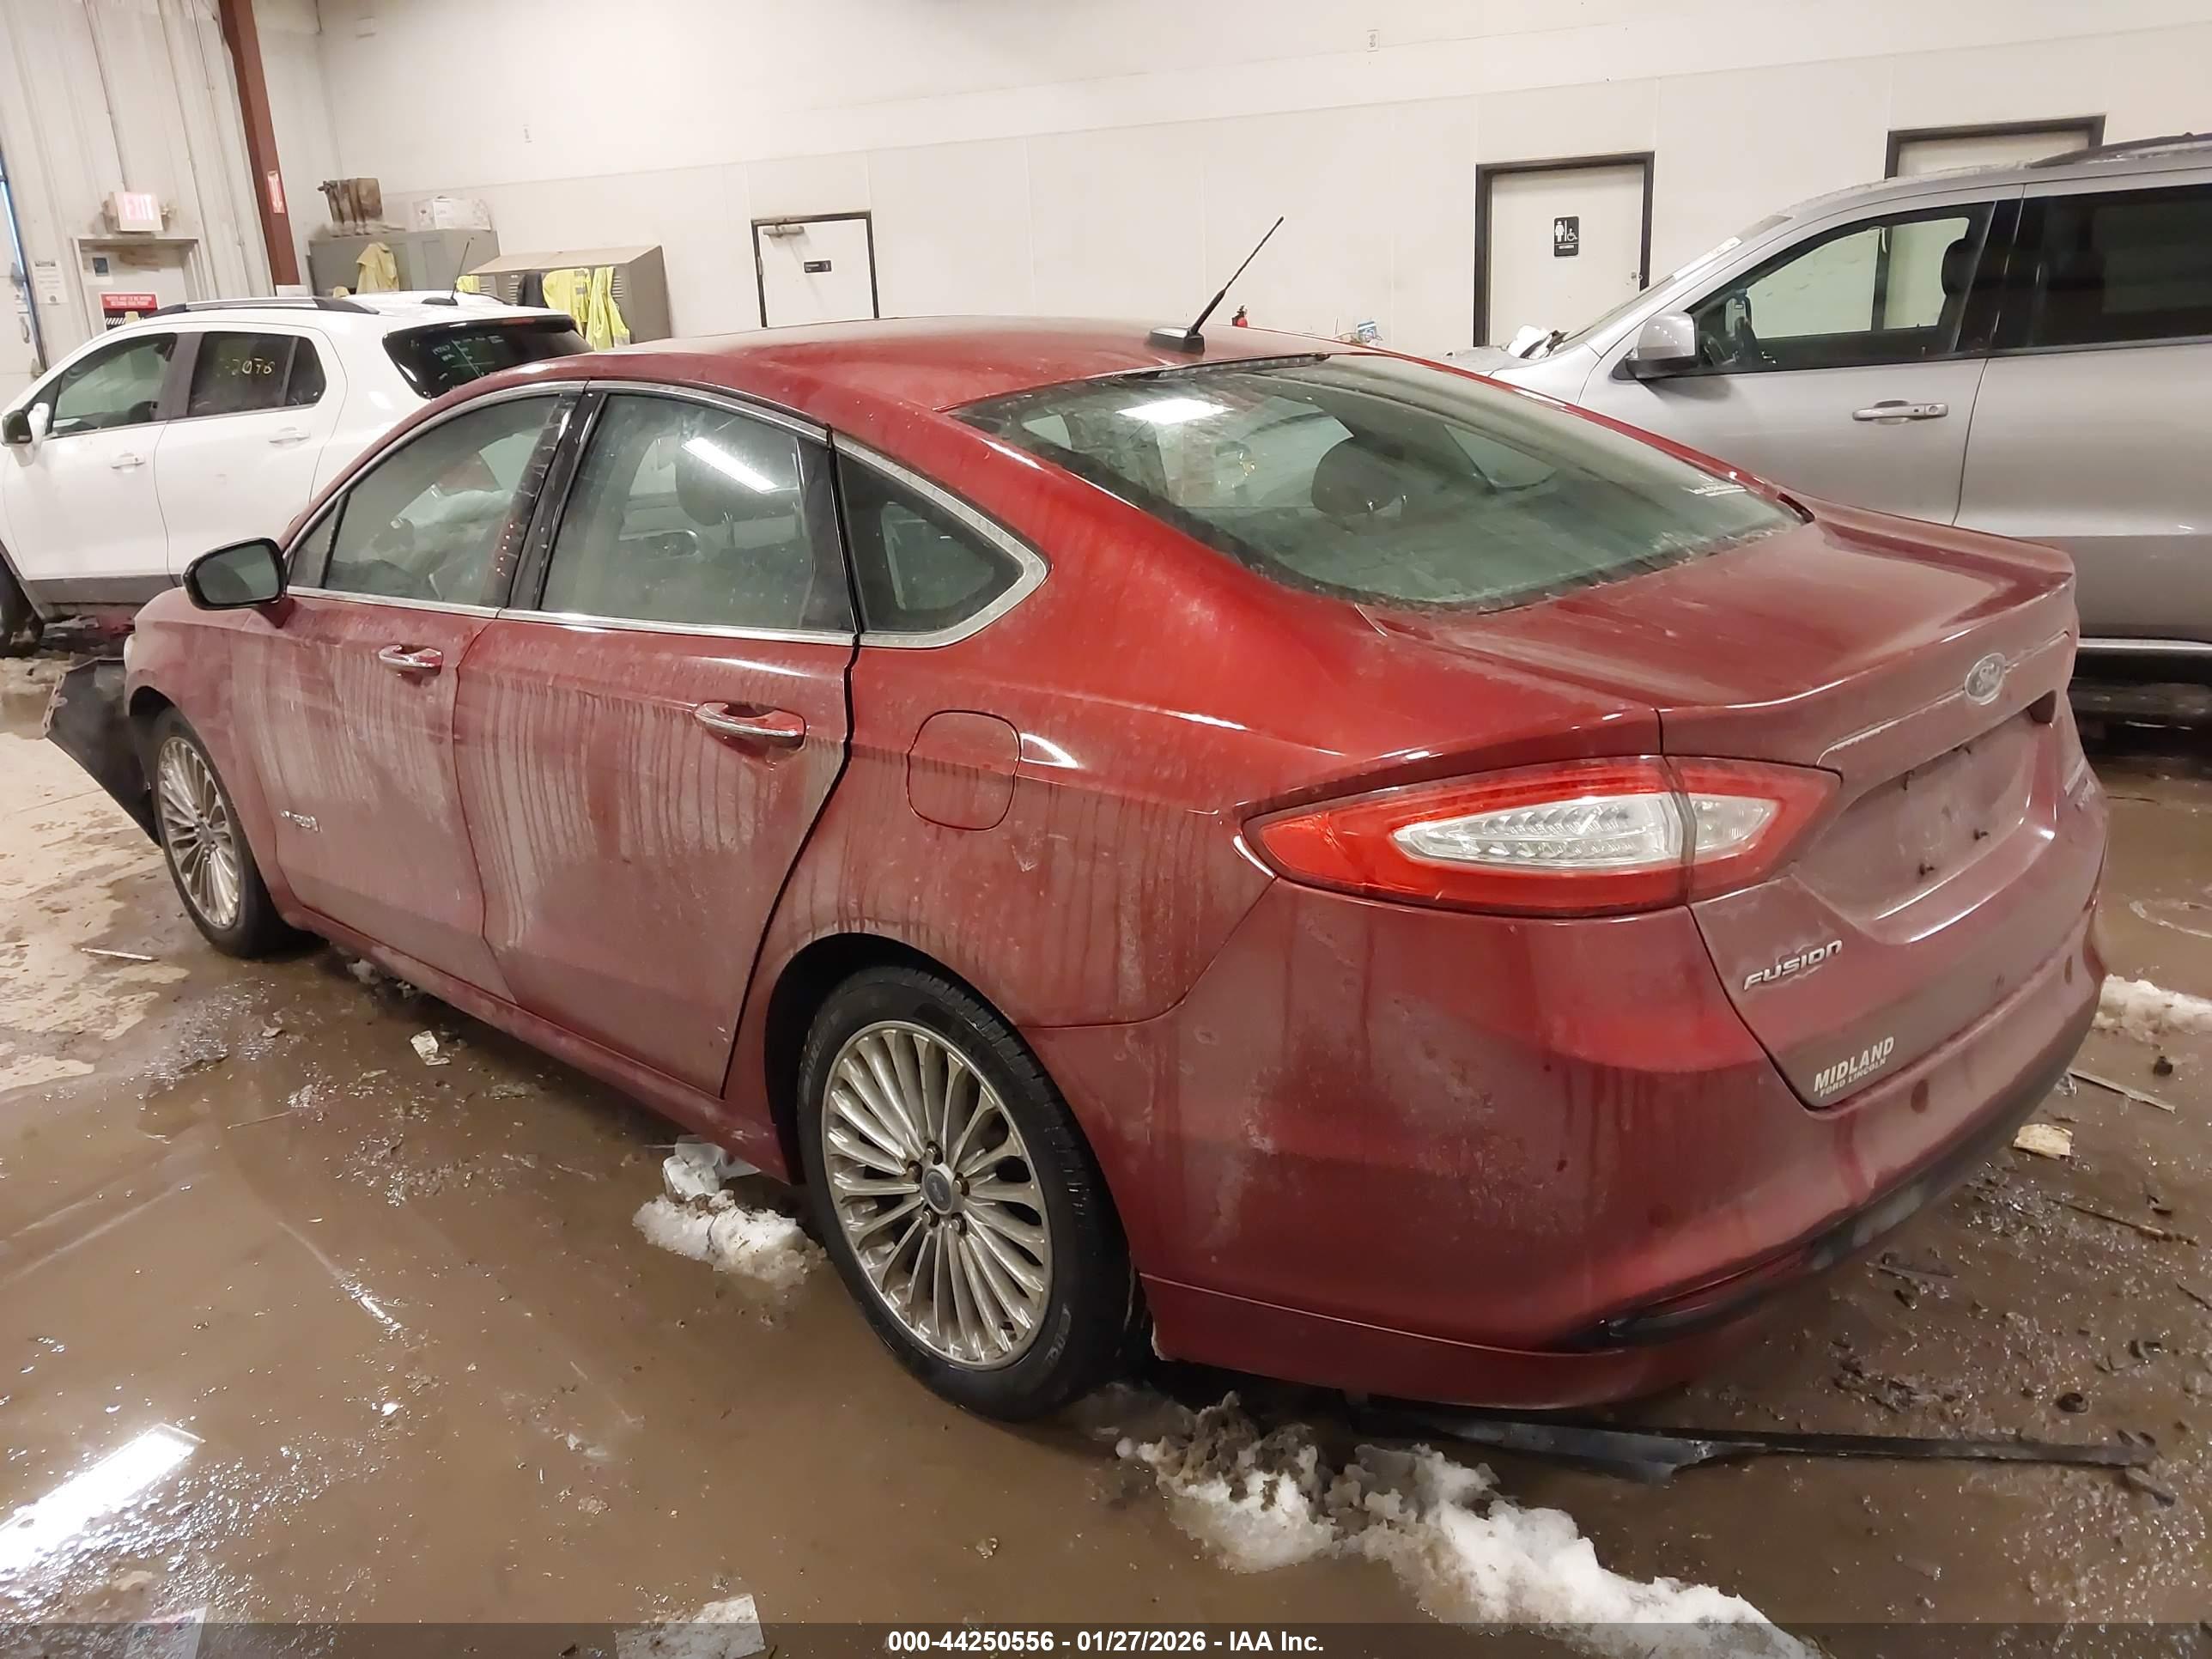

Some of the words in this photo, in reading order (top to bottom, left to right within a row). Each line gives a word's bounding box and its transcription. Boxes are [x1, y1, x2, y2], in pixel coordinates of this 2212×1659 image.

[1743, 939, 1843, 991] FUSION
[1814, 1036, 1894, 1092] MIDLAND
[1820, 1079, 1846, 1098] FORD
[1848, 1057, 1887, 1084] LINCOLN
